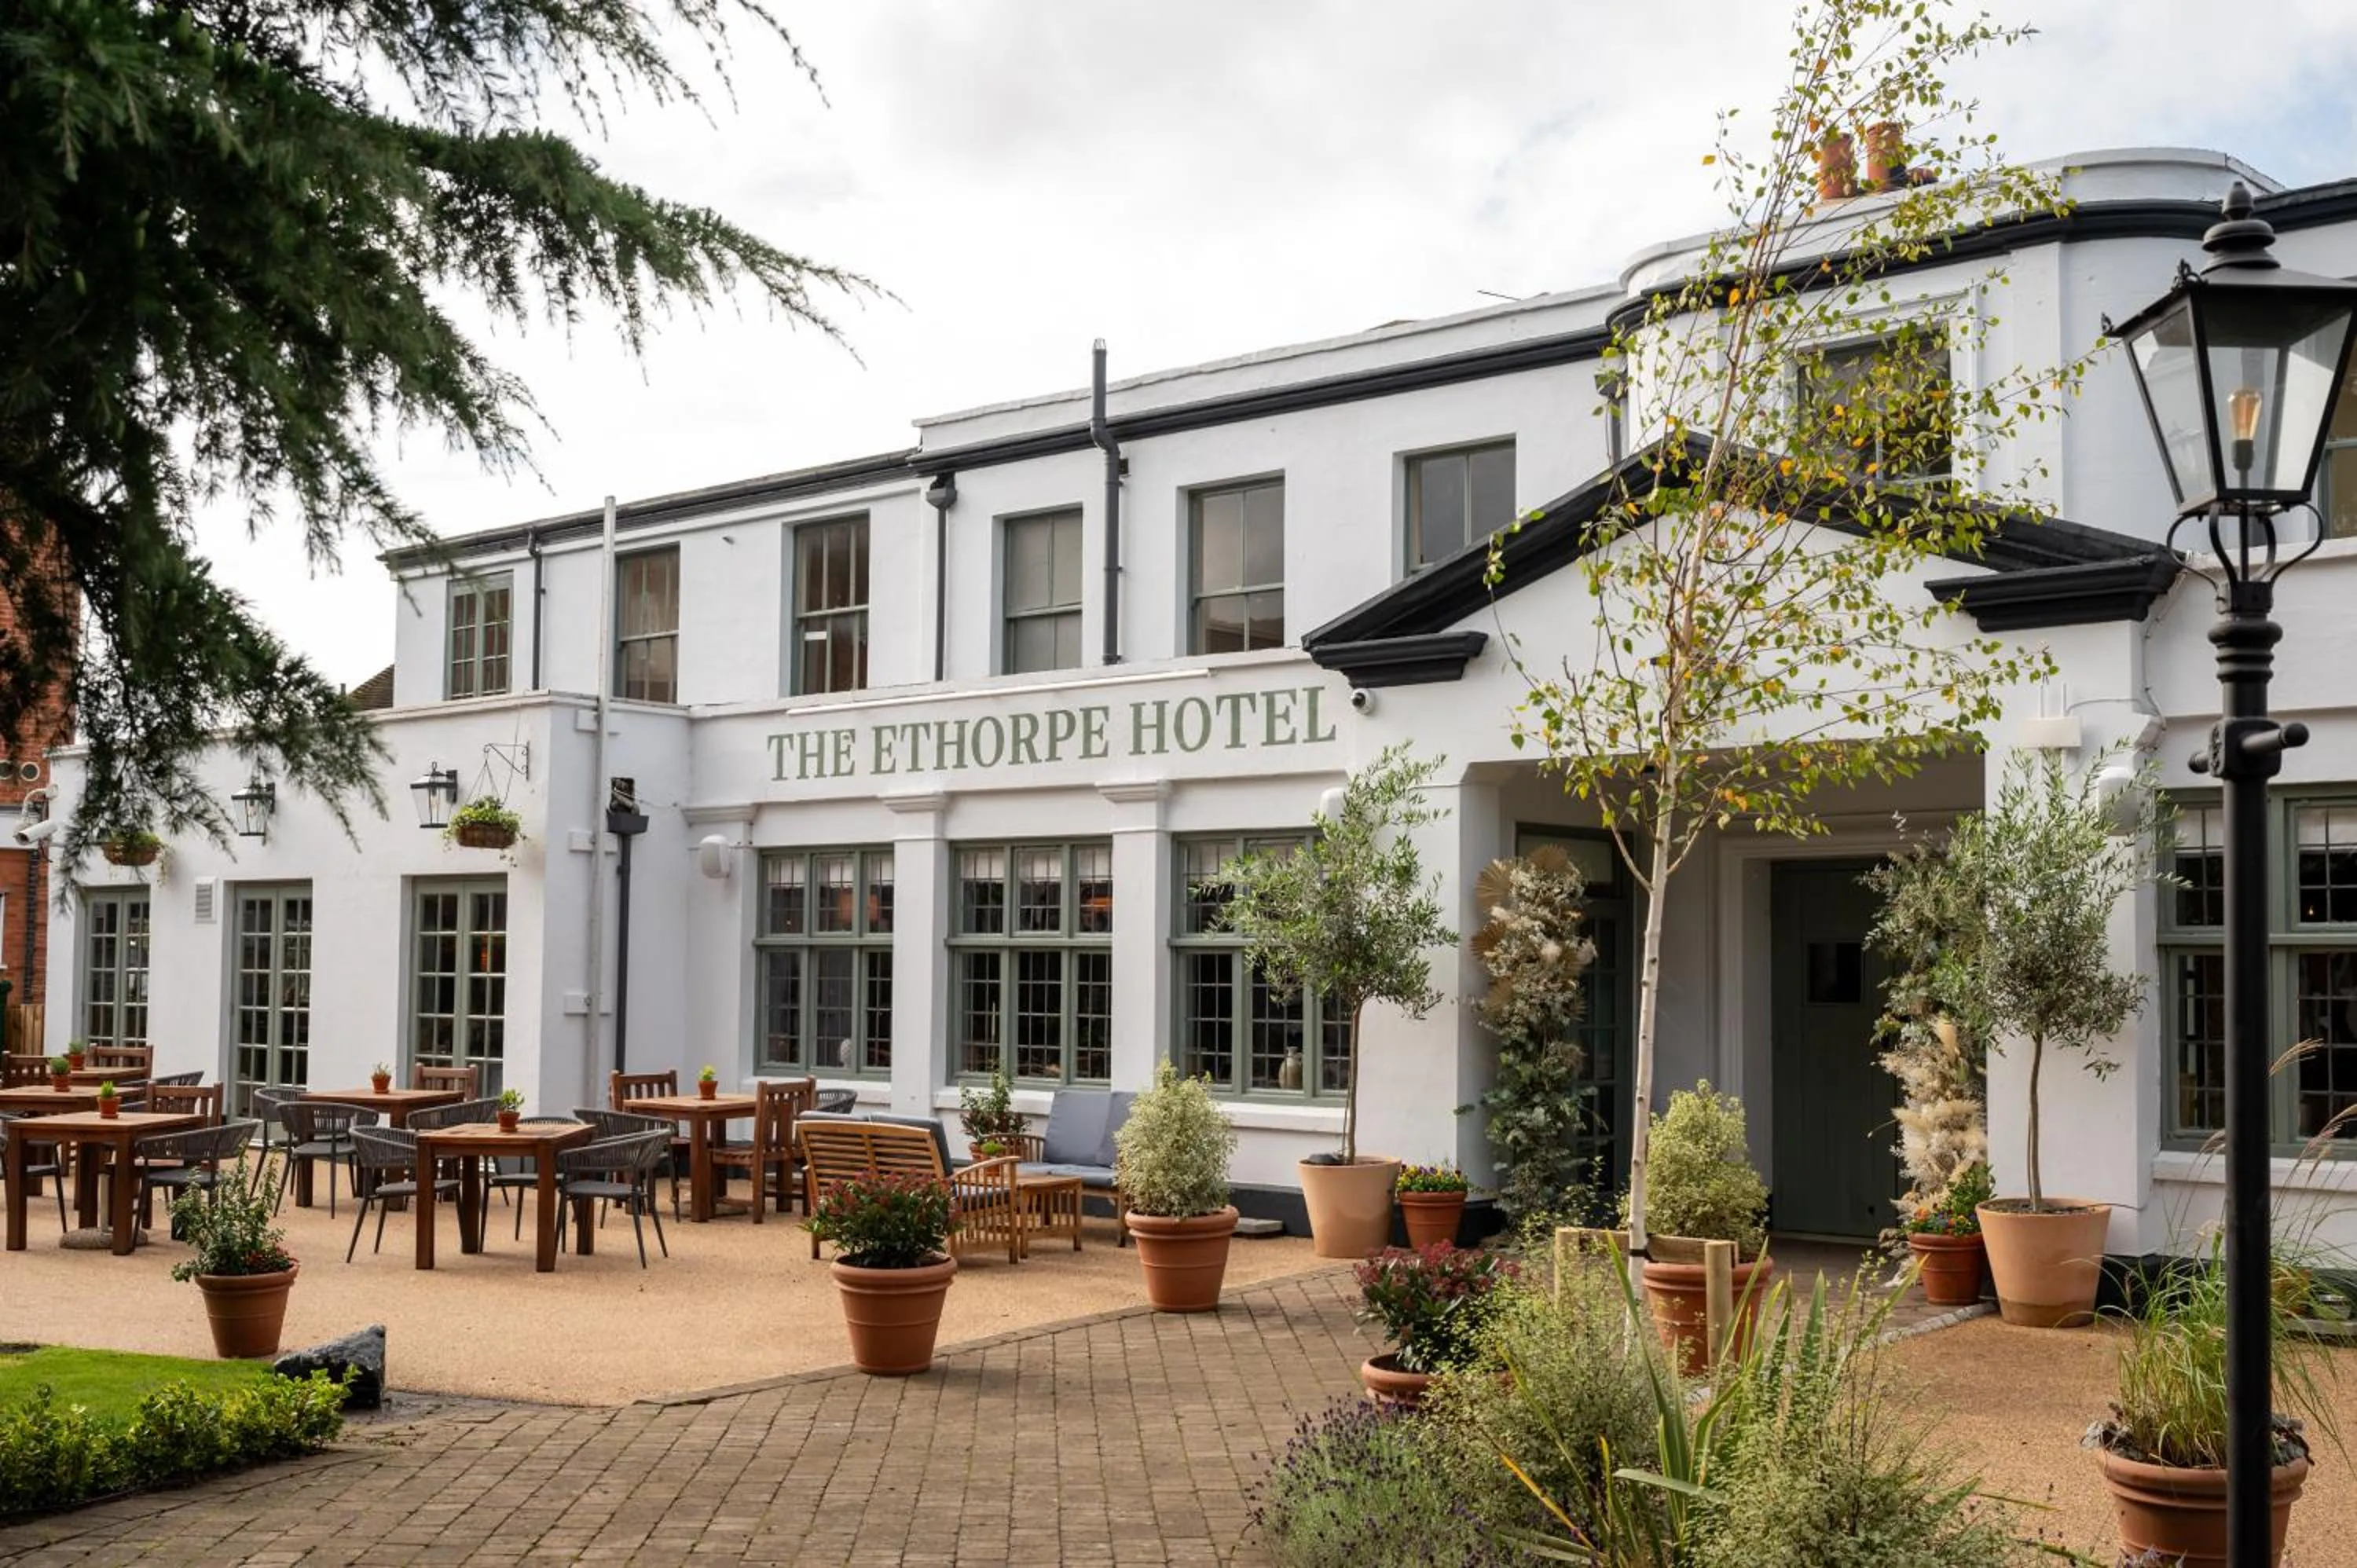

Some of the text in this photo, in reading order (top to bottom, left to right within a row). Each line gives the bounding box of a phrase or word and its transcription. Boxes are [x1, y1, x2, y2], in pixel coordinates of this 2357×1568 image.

[768, 686, 1336, 781] THE ETHORPE HOTEL
